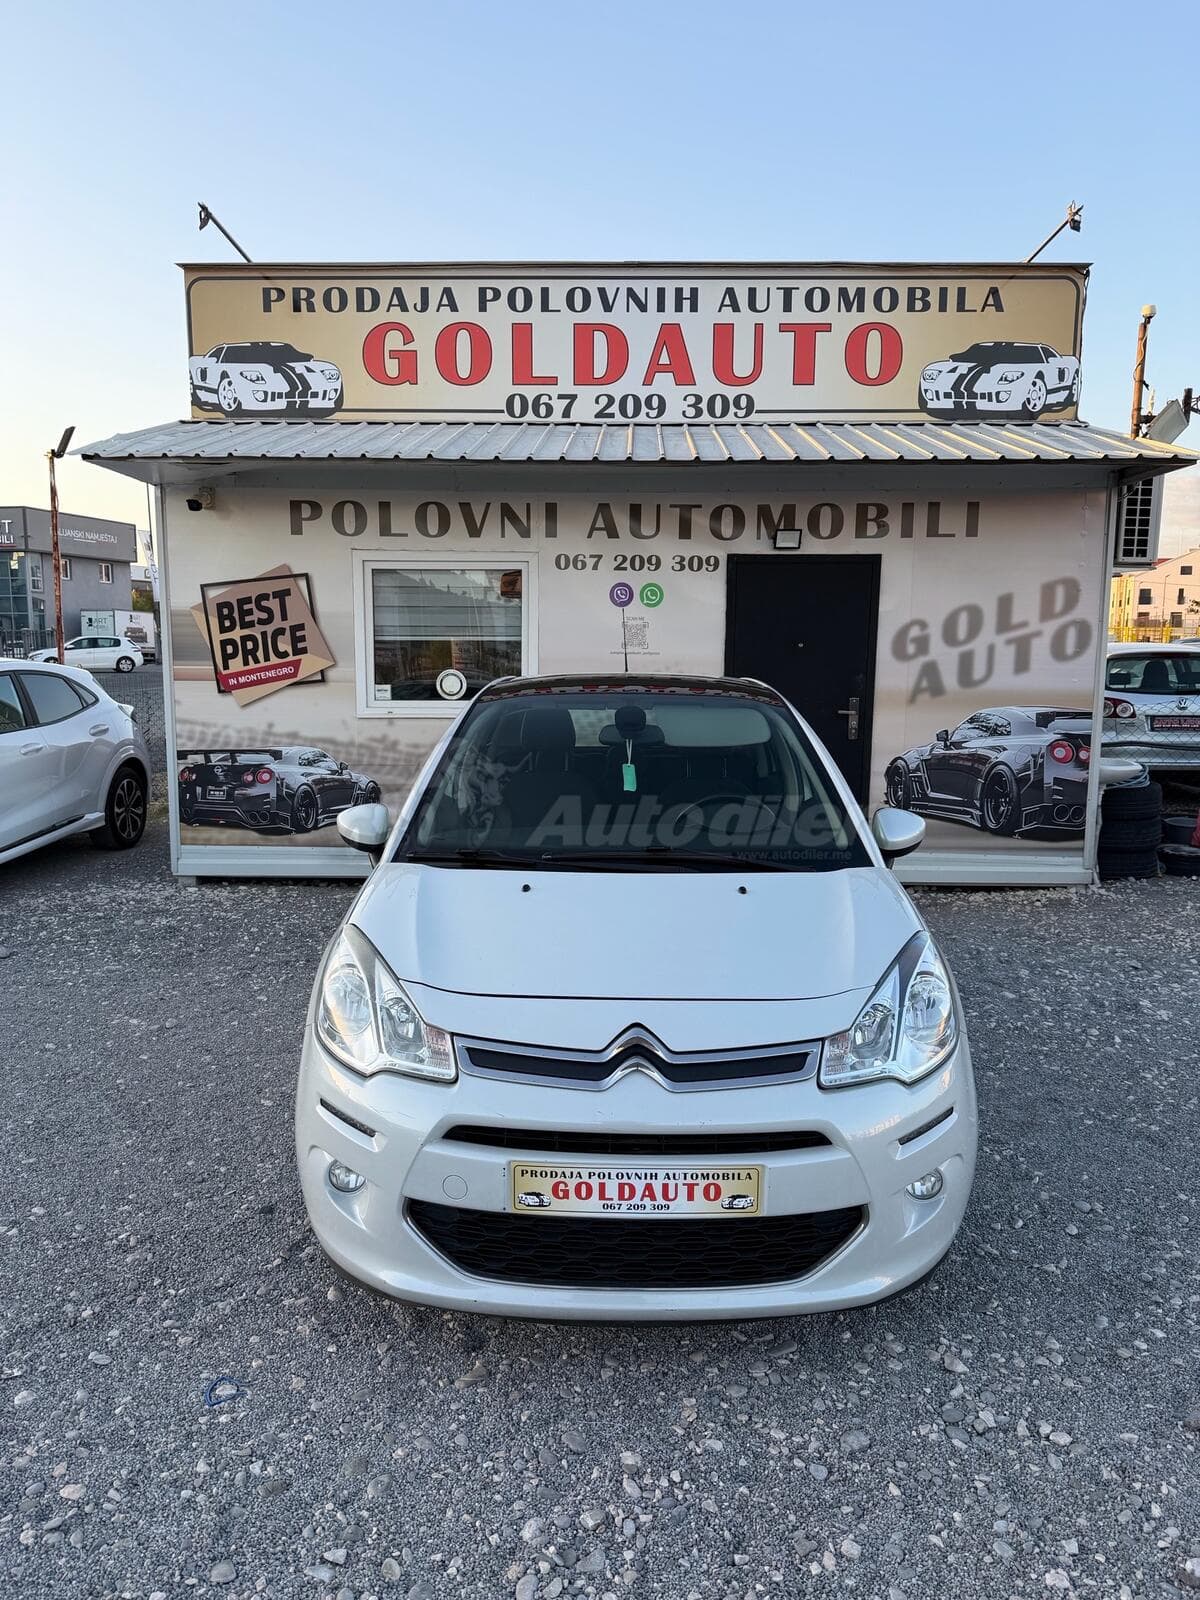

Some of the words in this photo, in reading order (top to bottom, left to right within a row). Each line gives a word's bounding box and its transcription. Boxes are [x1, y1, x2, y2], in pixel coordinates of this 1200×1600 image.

[261, 286, 460, 314] PRODAJA
[477, 286, 699, 314] POLOVNIH
[717, 286, 1006, 314] AUTOMOBILA
[362, 321, 904, 387] GOLDAUTO
[505, 393, 578, 420] 067
[594, 393, 667, 420] 209
[681, 393, 755, 420] 309
[289, 499, 559, 539] POLOVNI
[586, 501, 981, 541] AUTOMOBILI
[554, 553, 604, 572] 067
[613, 553, 662, 573] 209
[671, 554, 720, 573] 309
[216, 588, 292, 635] BEST
[891, 575, 1082, 663] GOLD
[219, 623, 309, 671] PRICE
[909, 616, 1093, 704] AUTO
[228, 676, 237, 686] IN
[238, 666, 295, 684] MONTENEGRO
[521, 1169, 583, 1179] PRODAJA
[588, 1171, 659, 1181] POLOVNIH
[663, 1171, 753, 1181] AUTOMOBILA
[551, 1180, 722, 1202] GOLDAUTO
[602, 1203, 622, 1211] 067
[626, 1203, 647, 1211] 209
[650, 1203, 670, 1211] 309
